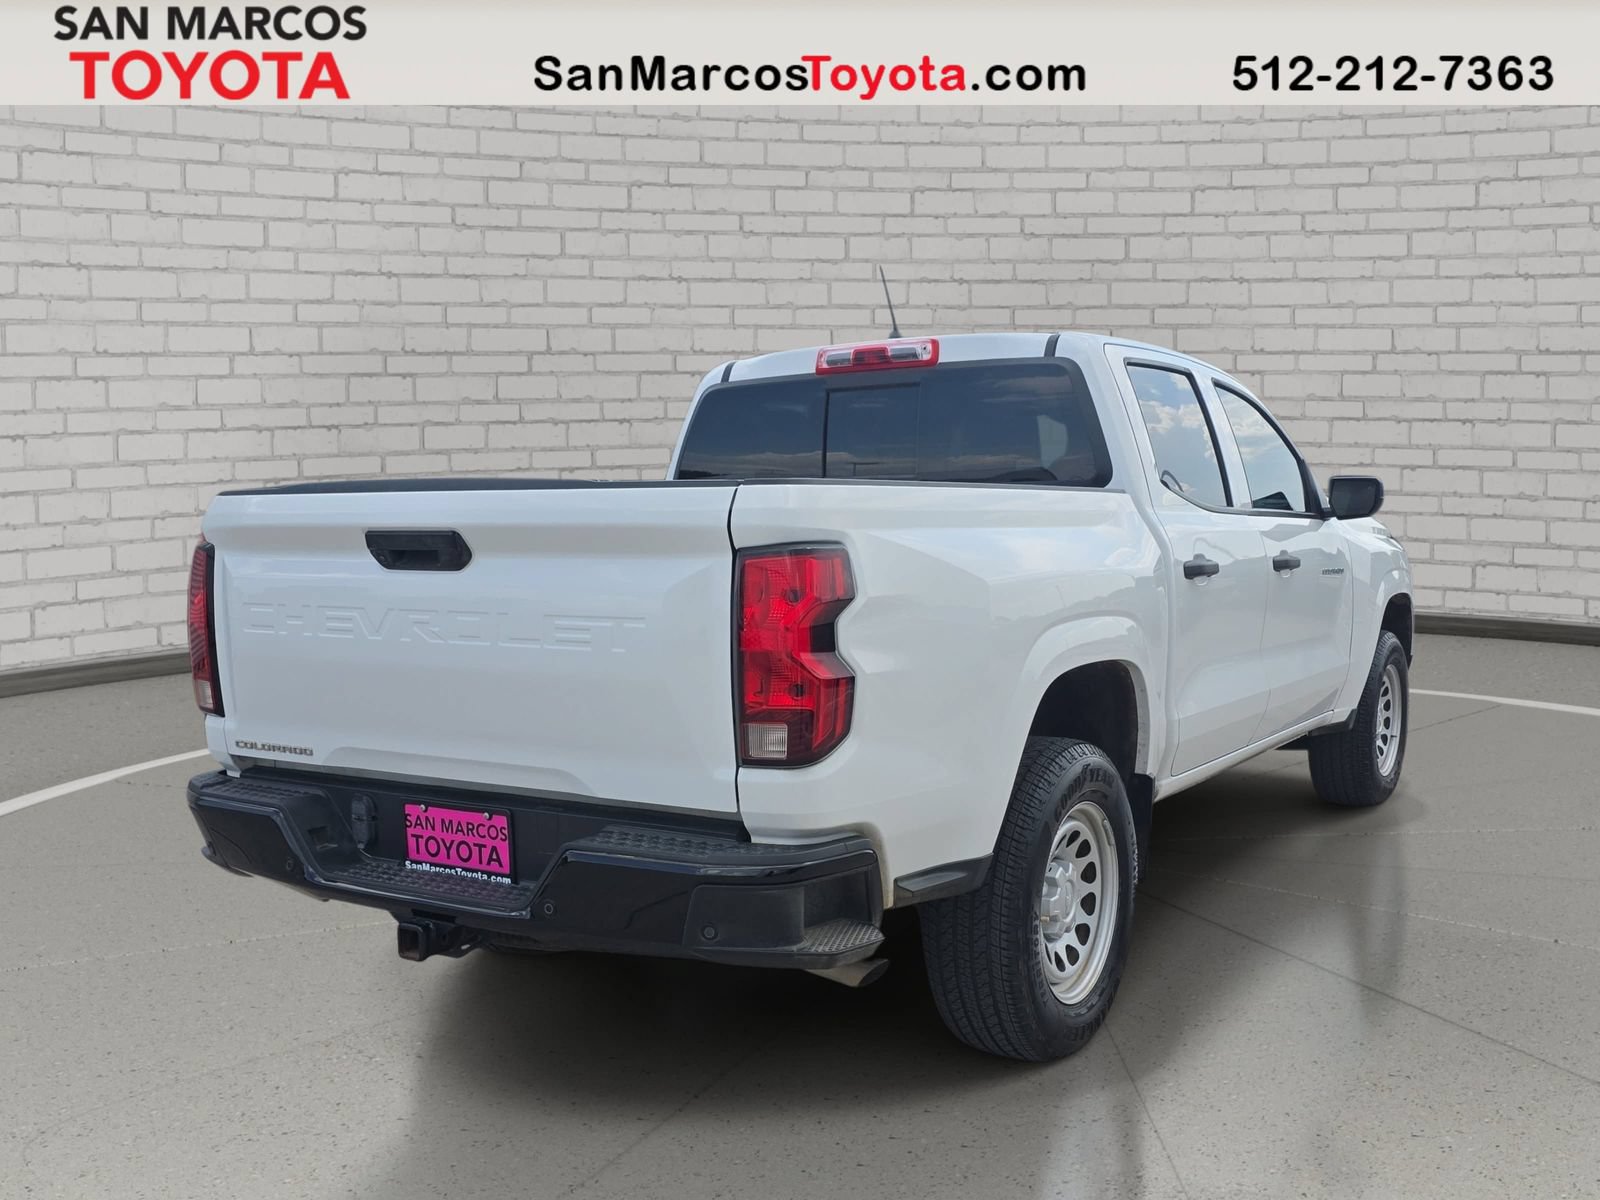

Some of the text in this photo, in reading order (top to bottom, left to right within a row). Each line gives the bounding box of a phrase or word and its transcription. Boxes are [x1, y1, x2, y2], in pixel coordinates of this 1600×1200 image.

[242, 601, 646, 654] CHEVROLET
[235, 740, 313, 756] COLORADO
[404, 813, 508, 842] SAN MARCOS
[411, 834, 504, 868] TOYOTA
[404, 860, 512, 885] SanMarcosToyota.com
